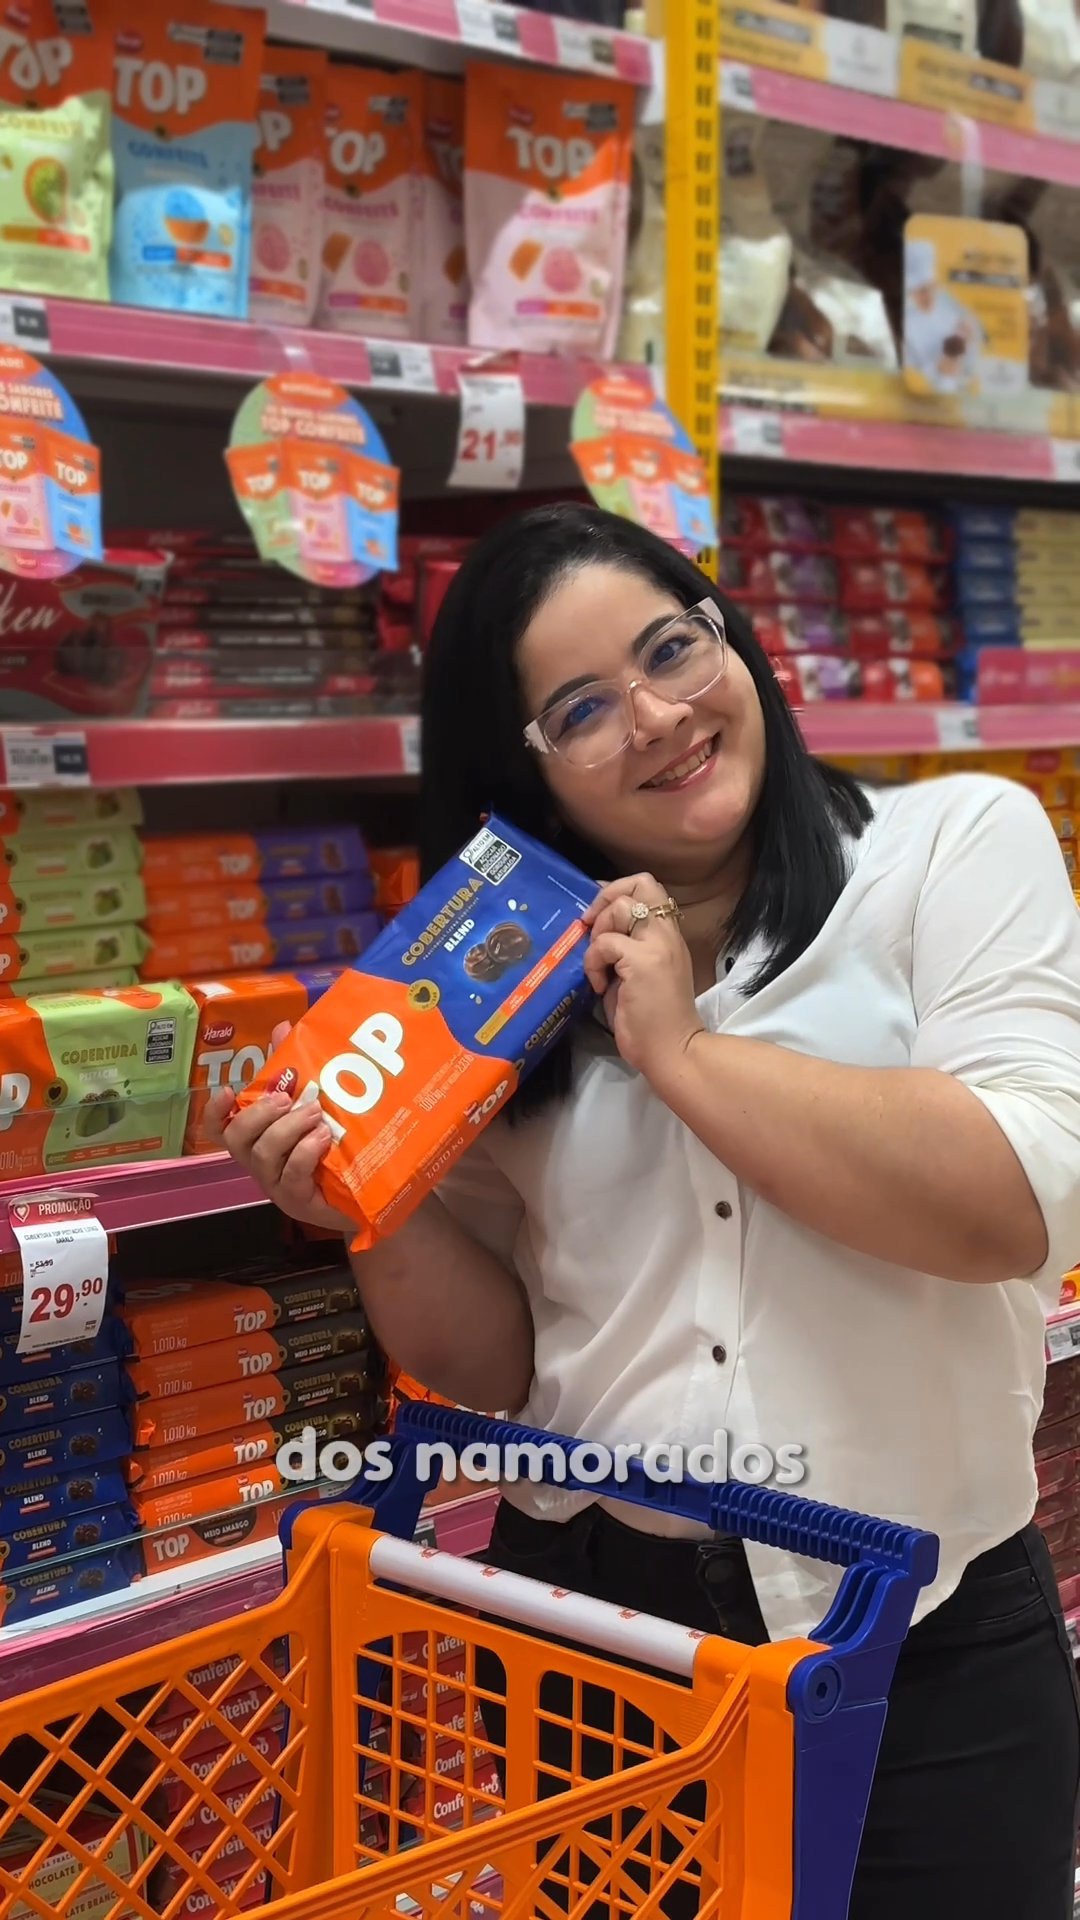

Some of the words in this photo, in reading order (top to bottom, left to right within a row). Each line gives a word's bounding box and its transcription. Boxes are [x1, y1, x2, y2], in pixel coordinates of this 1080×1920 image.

[114, 56, 207, 114] TOP
[326, 124, 387, 175] OP
[506, 126, 595, 178] TOP
[0, 394, 64, 422] ONFEITE
[54, 461, 87, 487] TOP
[401, 878, 484, 966] COBERTURA
[443, 919, 475, 952] BLEND
[229, 943, 265, 965] TOP
[524, 990, 578, 1050] COBERTURA
[204, 1026, 233, 1041] Harald
[61, 1043, 138, 1065] COBERTURA
[79, 1068, 118, 1081] PISTACHE
[197, 1045, 273, 1105] TO
[276, 1068, 294, 1094] rald
[468, 1080, 508, 1124] TOP
[38, 1198, 91, 1215] PROMOÇÃO
[284, 1288, 327, 1305] COBERTURA
[288, 1307, 302, 1317] MEIO
[302, 1302, 325, 1315] AMARGO
[233, 1310, 267, 1334] TOP
[288, 1330, 333, 1347] COBERTURA
[294, 1349, 309, 1360] MEIO
[308, 1343, 332, 1357] AMARGO
[239, 1352, 273, 1377] TOP
[8, 1376, 62, 1395] COBERTURA
[293, 1372, 338, 1391] COBERTURA
[29, 1395, 49, 1405] BLEND
[297, 1393, 312, 1403] MEIO
[312, 1386, 335, 1400] AMARGO
[243, 1396, 276, 1421] TOP
[284, 1415, 330, 1433] COBERTURA
[8, 1429, 62, 1449] COBERTURA
[27, 1449, 47, 1460] BLEND
[233, 1438, 269, 1464] TOP
[4, 1476, 59, 1495] COBERTURA
[239, 1480, 274, 1502] TOP
[23, 1494, 45, 1504] BLEND
[13, 1519, 67, 1541] COBERTURA
[204, 1528, 221, 1539] MEIO
[222, 1518, 249, 1535] AMARGO
[32, 1539, 52, 1550] BLEND
[153, 1534, 190, 1561] TOP
[20, 1566, 73, 1587] COBERTURA
[36, 1584, 56, 1596] BLEND
[433, 1773, 498, 1819] Confeiro
[28, 1865, 75, 1890] HOCOLATE
